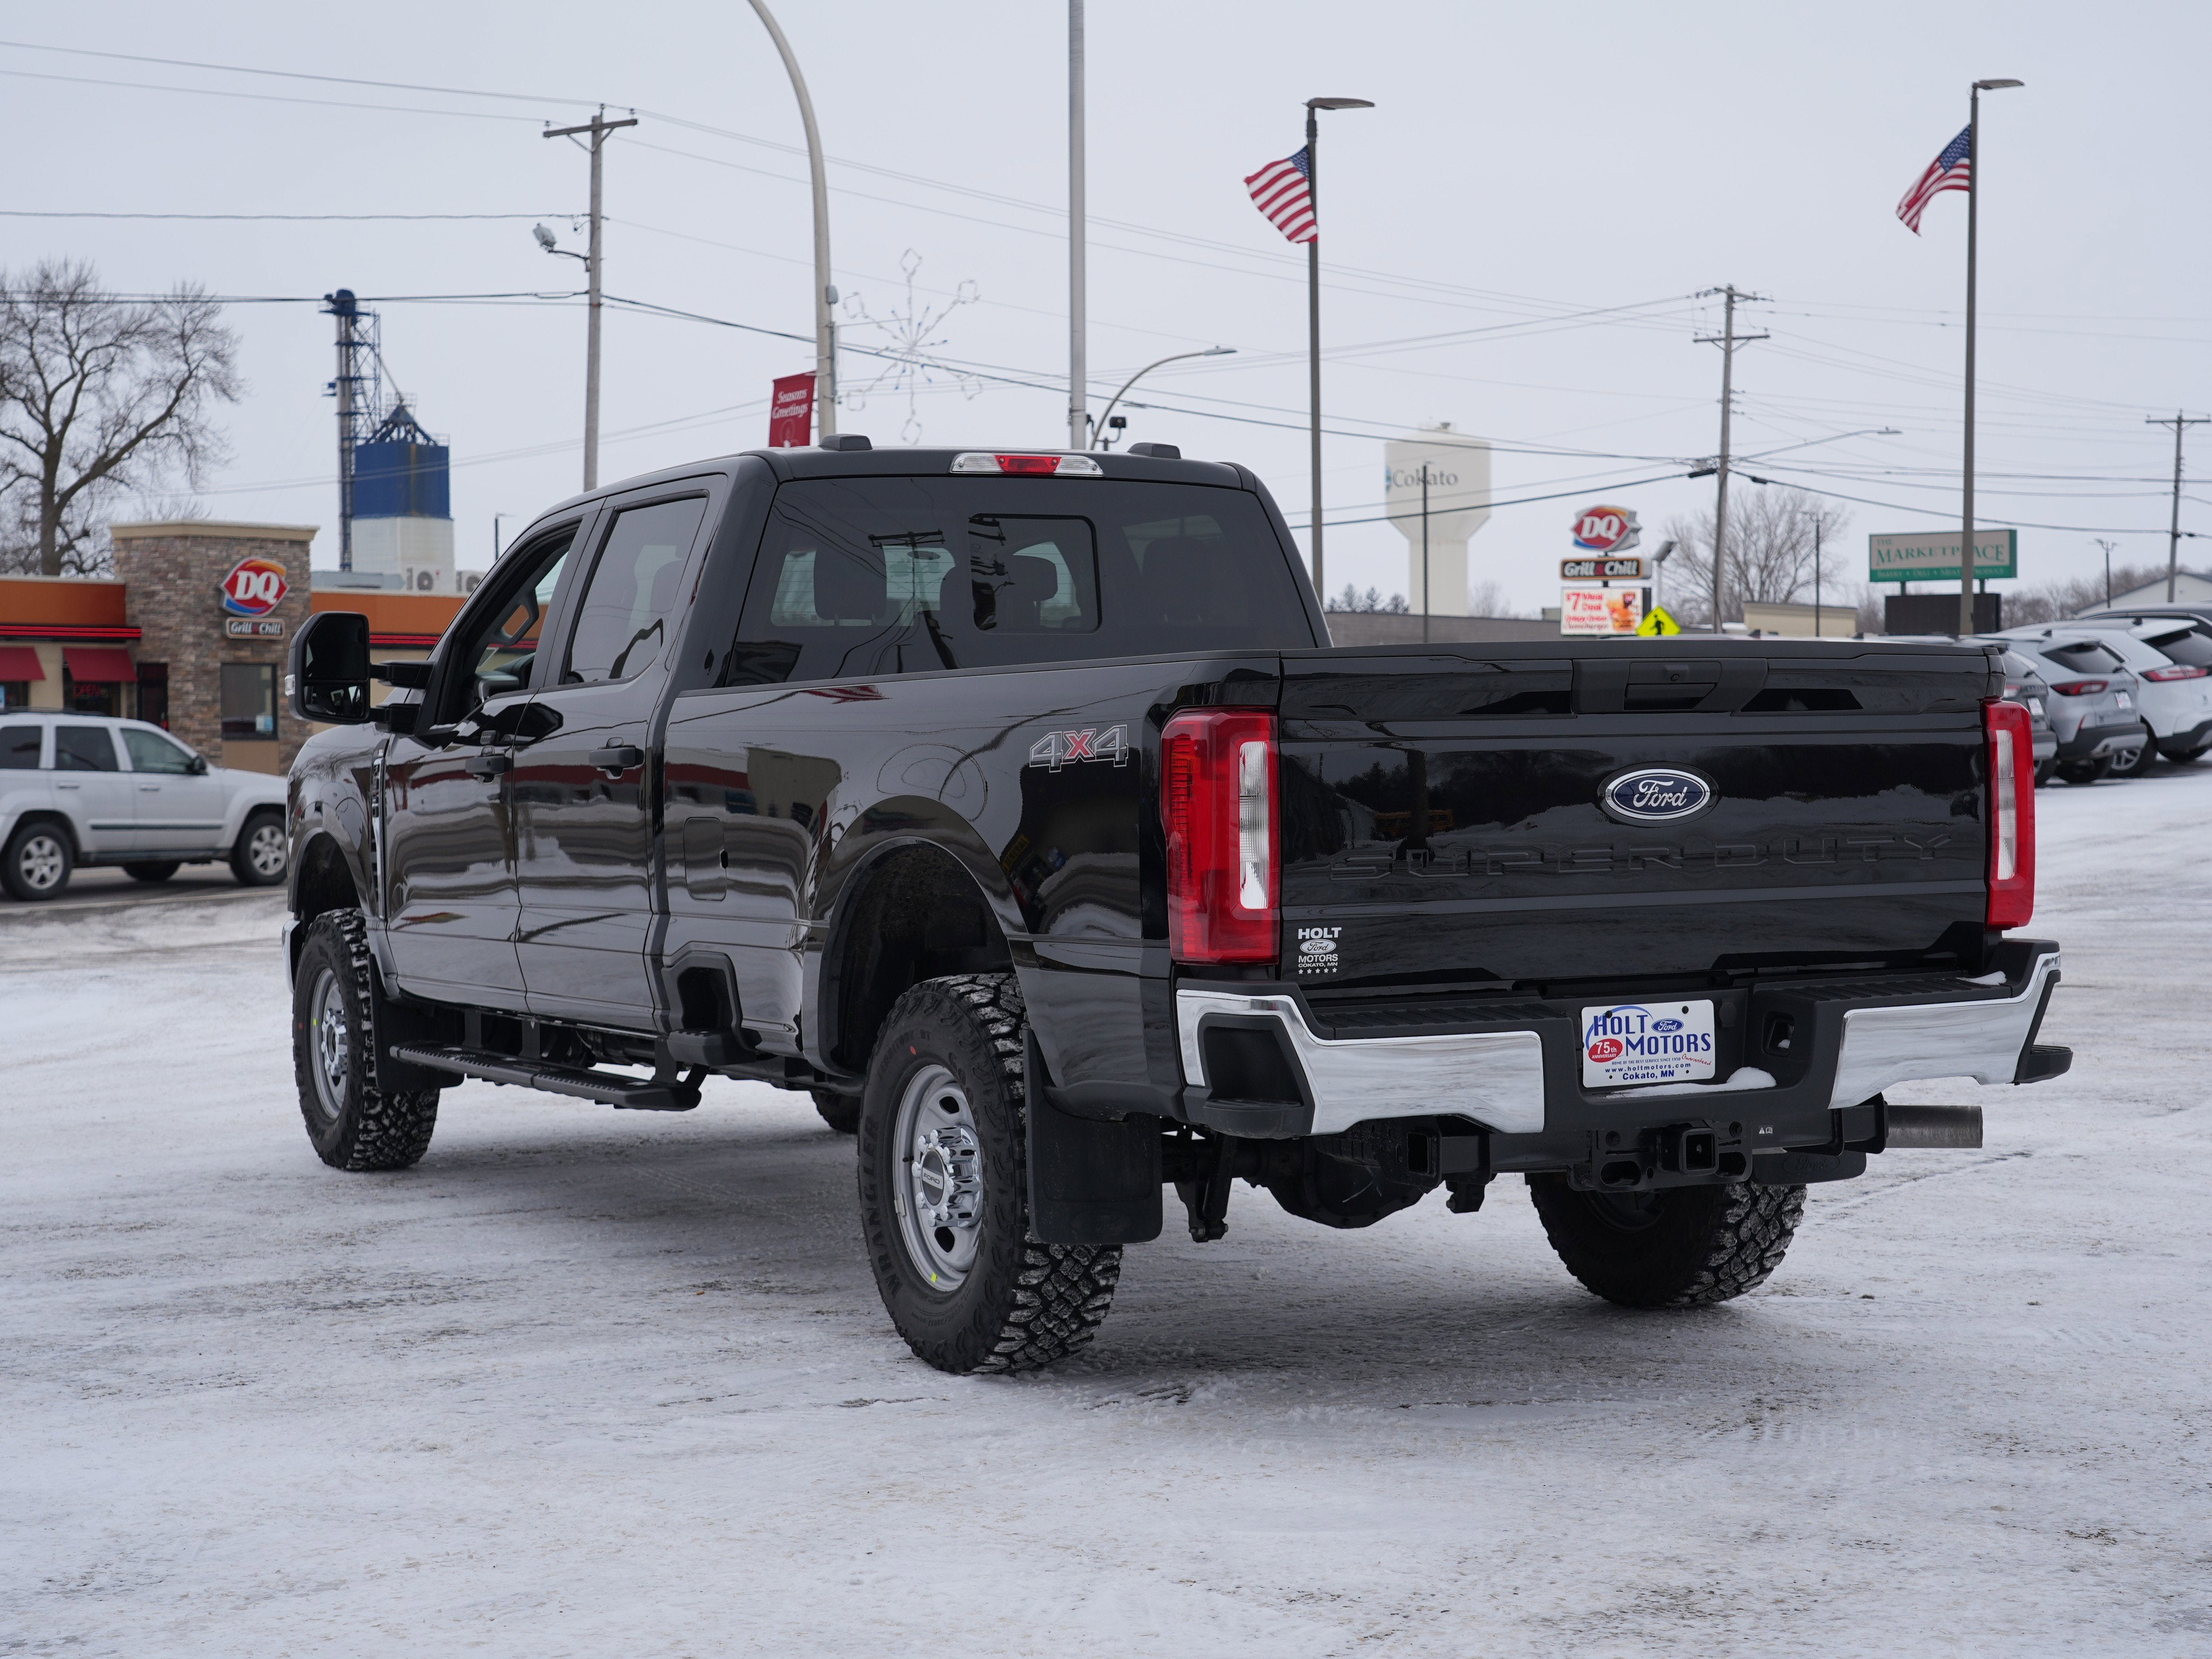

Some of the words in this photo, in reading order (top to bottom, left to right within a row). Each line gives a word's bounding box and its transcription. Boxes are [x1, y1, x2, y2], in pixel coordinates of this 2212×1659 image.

[777, 388, 808, 404] Seasons
[772, 403, 809, 419] Greetings
[1580, 515, 1620, 541] DQ
[1876, 544, 2005, 566] MARKETPACE
[1564, 561, 1596, 577] Grill
[1604, 560, 1638, 576] Chill
[234, 570, 280, 605] DQ
[231, 622, 252, 634] Grill
[259, 623, 282, 635] Chill
[1633, 779, 1688, 807] Ford
[1329, 841, 1685, 881] SUPER
[1714, 832, 1953, 867] DUTY
[1298, 927, 1342, 939] HOLT
[1307, 941, 1329, 951] Ford
[1298, 954, 1338, 963] MOTORS
[1594, 1014, 1648, 1036] HOLT
[1658, 1021, 1677, 1031] Ford
[1596, 1041, 1617, 1054] 75th
[1626, 1033, 1711, 1056] MOTORS
[1682, 1054, 1711, 1065] Guaranteed
[1605, 1063, 1690, 1073] www.holtmotors.com
[923, 1173, 940, 1184] FORD
[864, 1115, 902, 1299] WRANGLER
